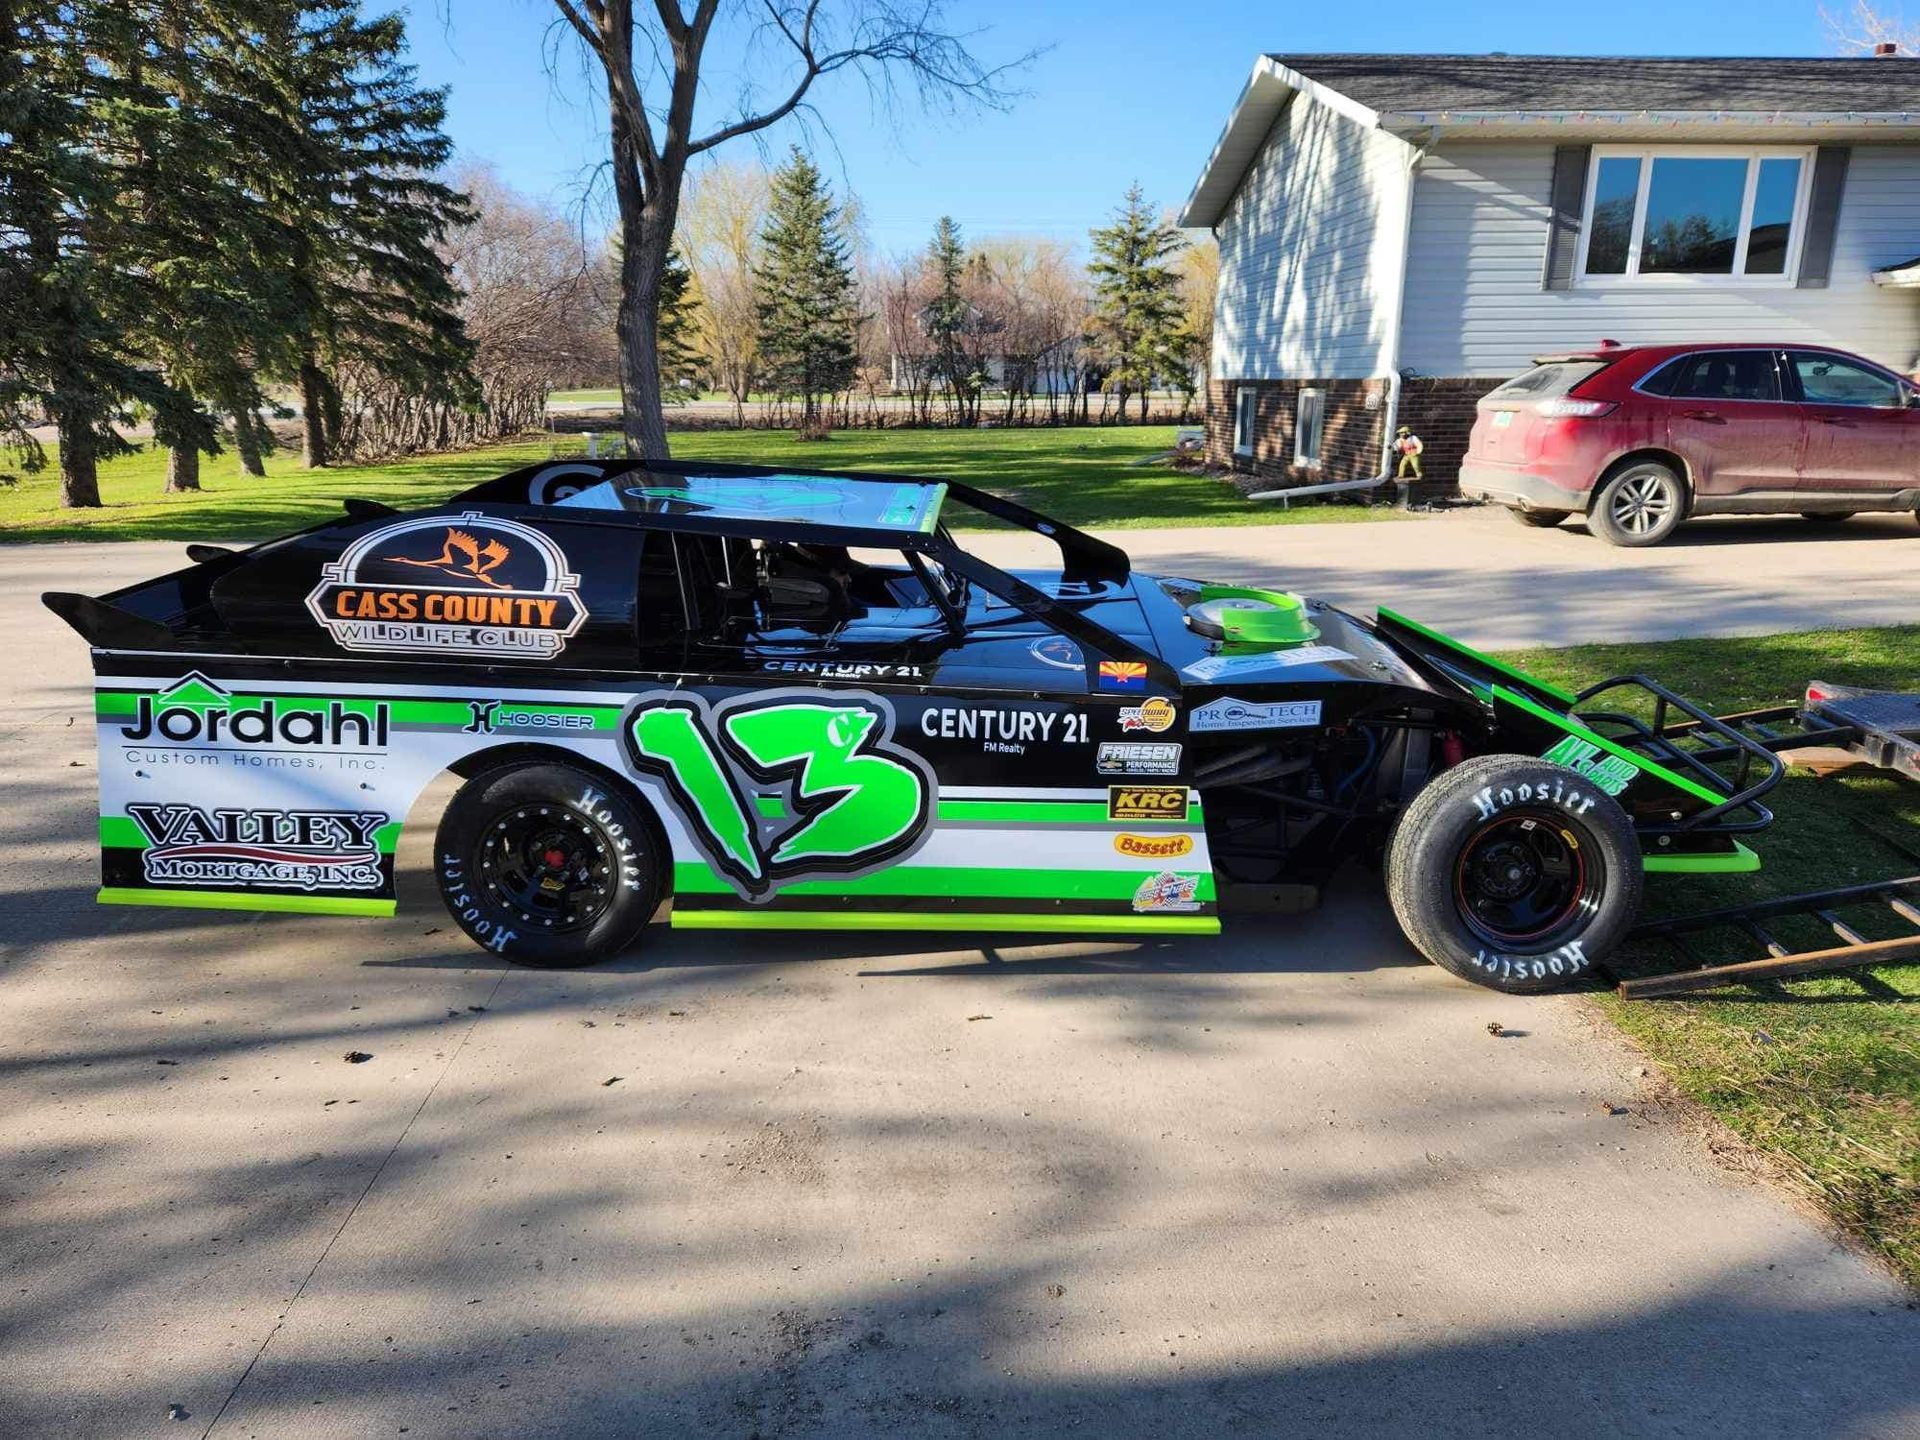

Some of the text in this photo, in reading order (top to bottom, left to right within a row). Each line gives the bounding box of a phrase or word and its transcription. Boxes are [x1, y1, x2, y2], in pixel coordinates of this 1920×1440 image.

[336, 590, 558, 626] CASS COUNTY
[337, 623, 557, 649] WILDLIFE CLUB
[764, 661, 892, 675] CENTURY
[121, 697, 388, 747] Jordahl
[499, 712, 595, 730] HOOSIER
[1196, 717, 1318, 729] Home Inspection Services
[1265, 705, 1317, 717] TECH
[921, 708, 1057, 742] CENTURY
[126, 751, 385, 771] Custom Homes, Inc.
[983, 742, 1026, 755] FM Realty
[1099, 745, 1178, 760] FRIESEN
[1126, 761, 1176, 769] PERFORMANCE
[1601, 757, 1638, 780] AUTO
[626, 700, 926, 885] 13
[1588, 769, 1627, 795] PARTS
[1115, 792, 1184, 809] KRC
[1472, 778, 1595, 822] Hoosier
[127, 805, 387, 849] VALLEY
[570, 785, 643, 892] Hoosier
[1119, 837, 1186, 854] Bassett
[150, 859, 377, 885] MORTGAGE, INC.
[444, 852, 519, 954] Hoosier
[1471, 940, 1590, 983] Hoosier
